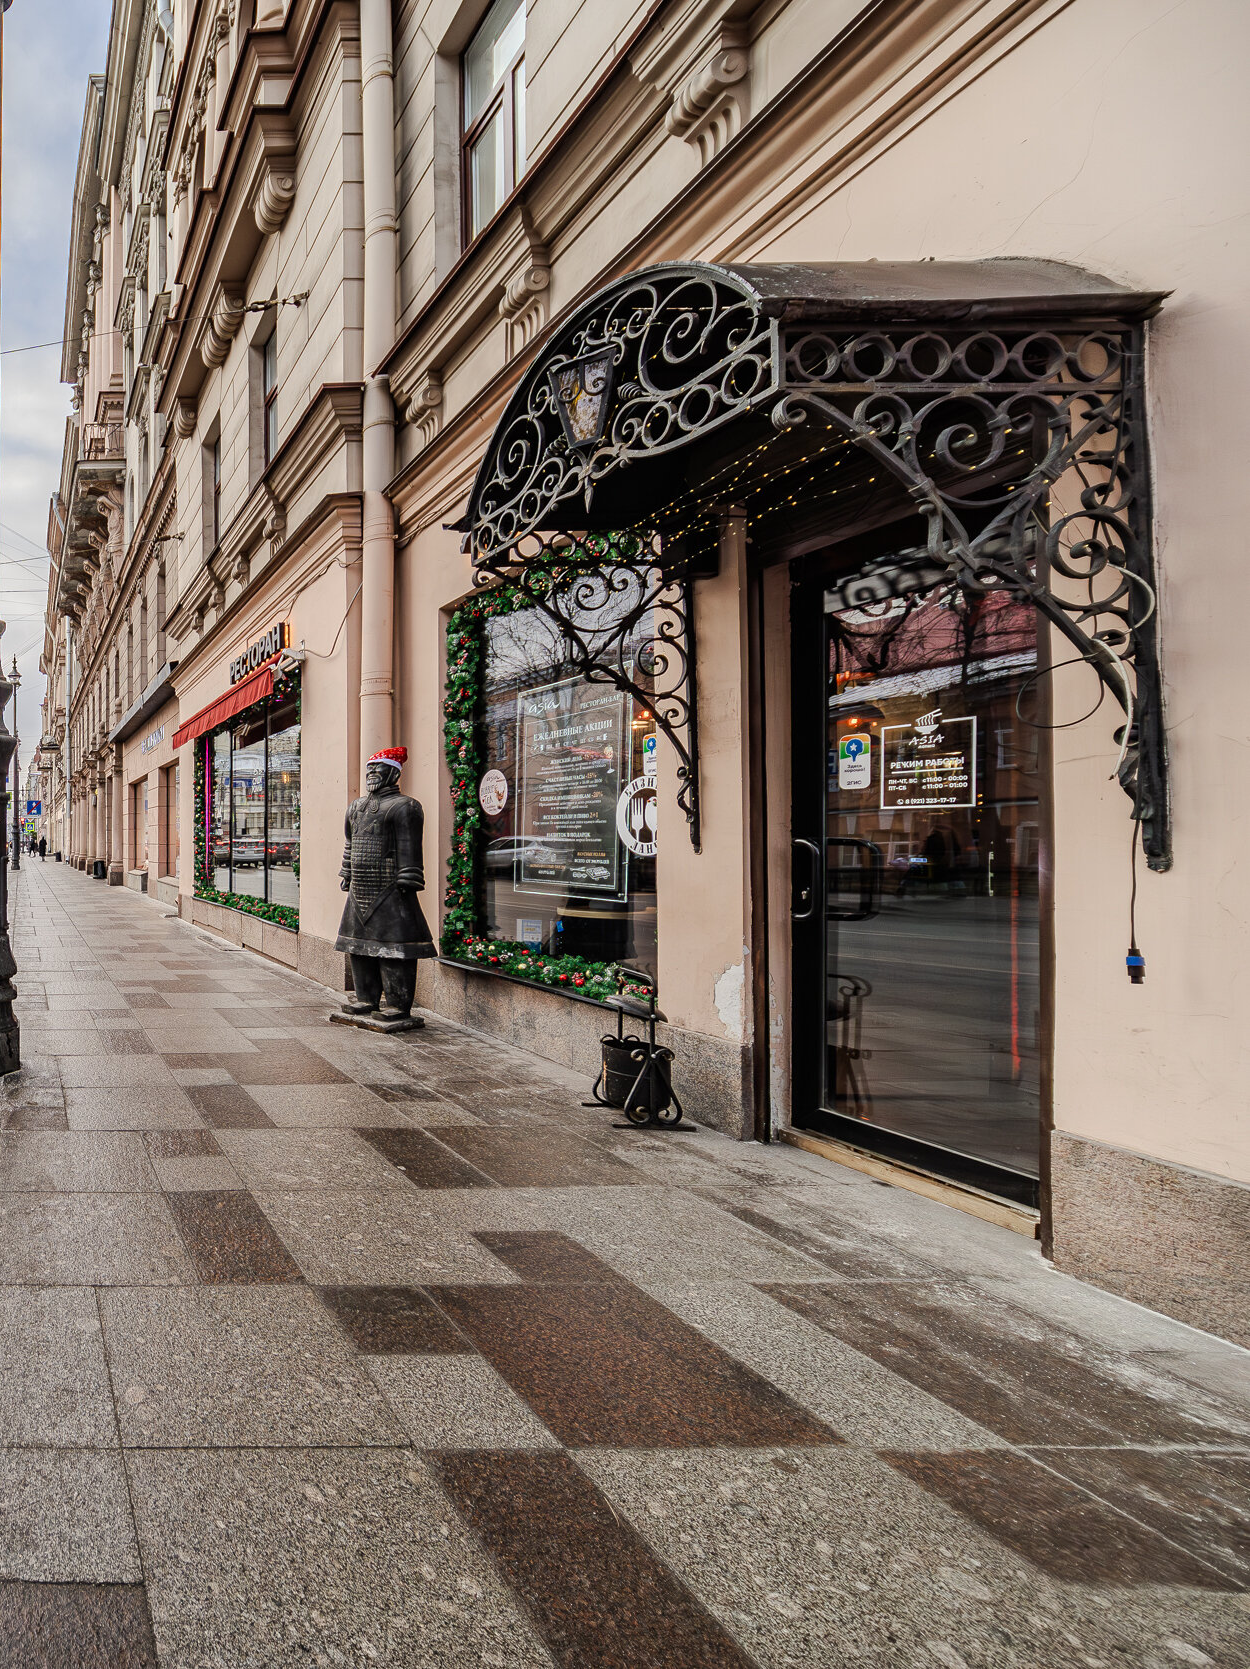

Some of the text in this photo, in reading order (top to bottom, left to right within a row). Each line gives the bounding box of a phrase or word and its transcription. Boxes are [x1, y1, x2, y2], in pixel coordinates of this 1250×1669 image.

[230, 622, 282, 685] РЕСТОРАН
[533, 719, 613, 741] ЕЖЕДНЕВНЫЕ АКЦИИ
[908, 734, 945, 746] ASIA
[890, 757, 965, 770] РЕЖИМ РАБОТЫ
[624, 777, 657, 797] БИЗН
